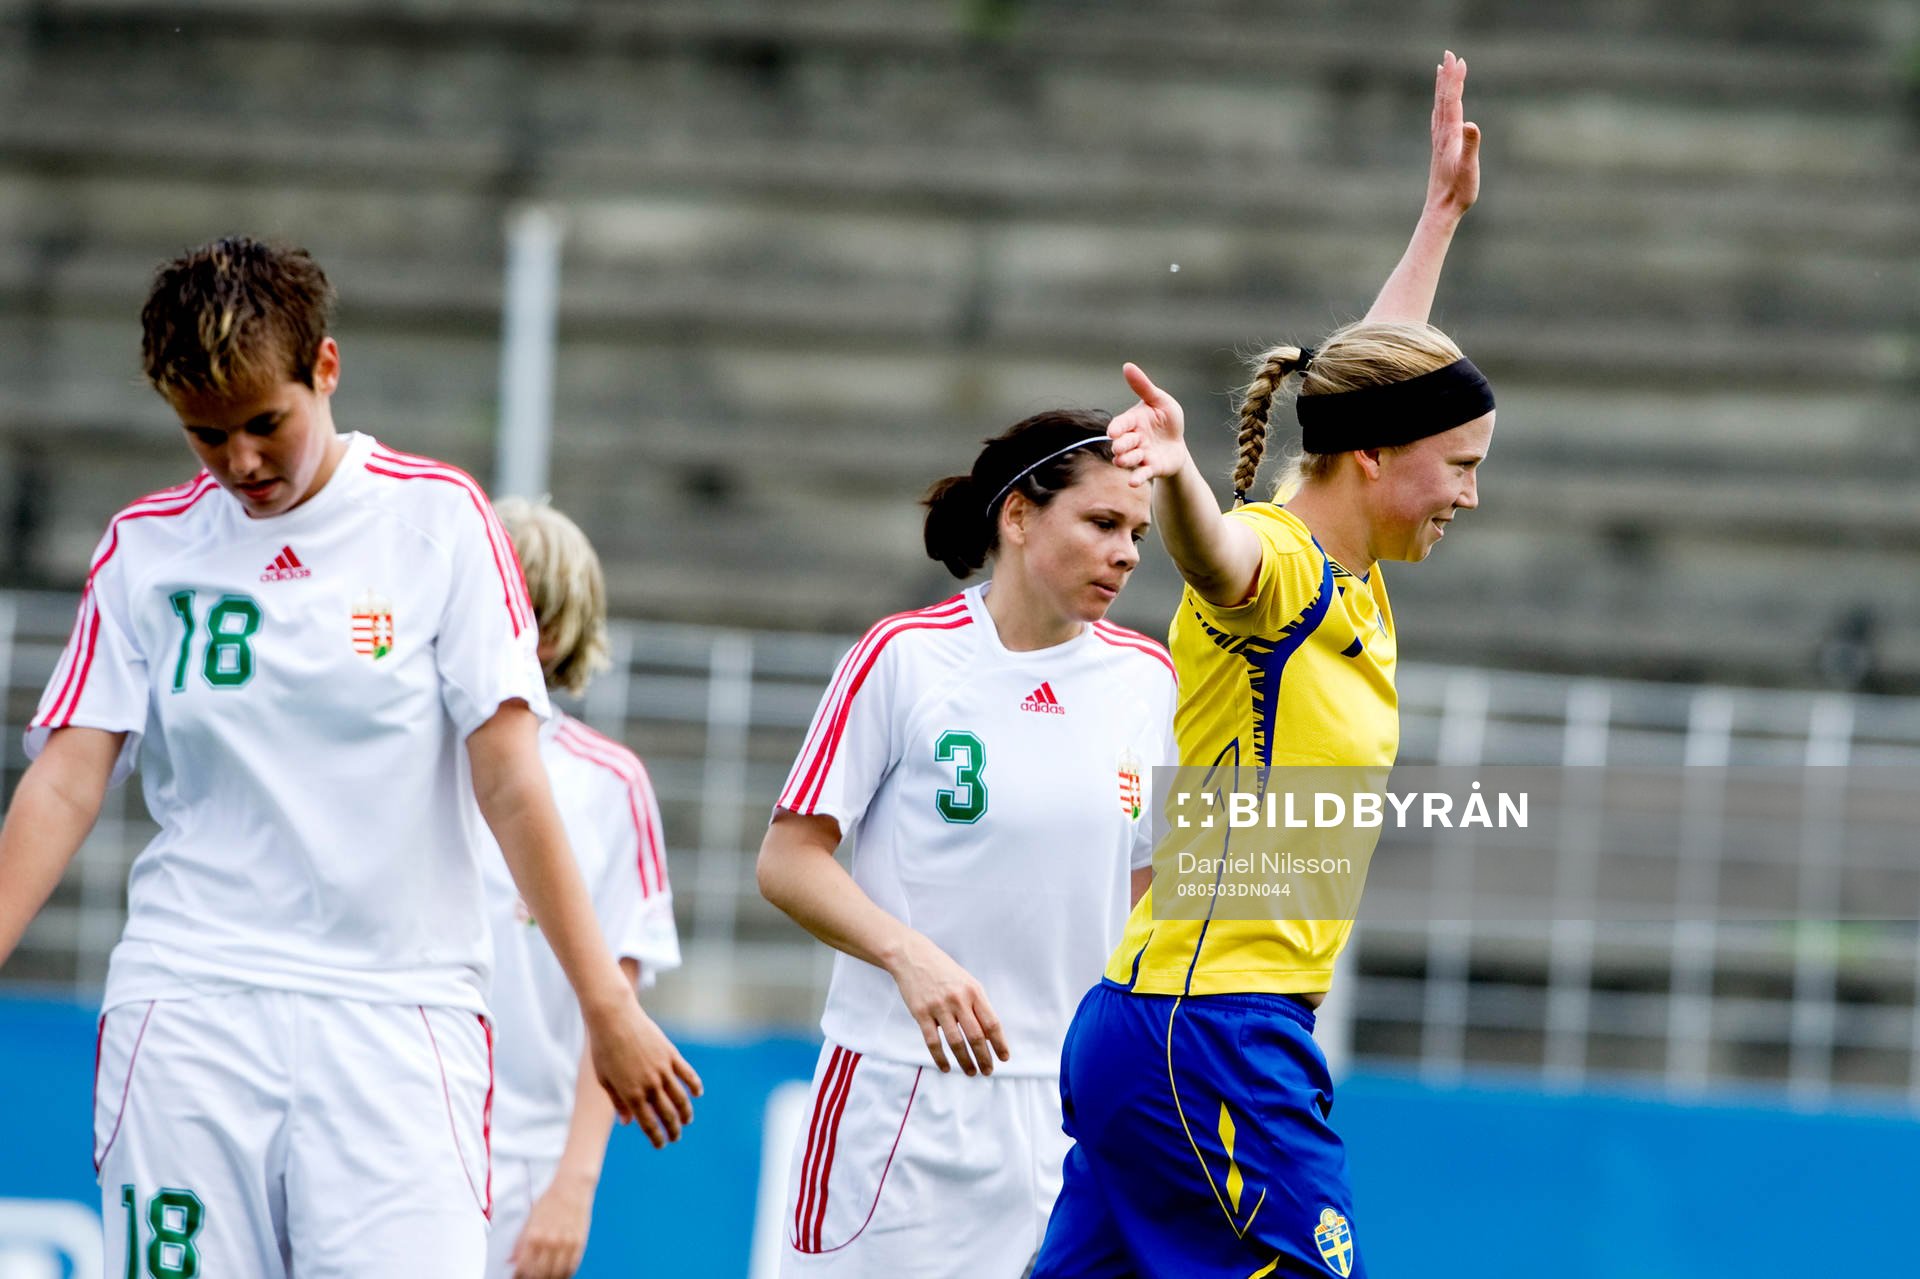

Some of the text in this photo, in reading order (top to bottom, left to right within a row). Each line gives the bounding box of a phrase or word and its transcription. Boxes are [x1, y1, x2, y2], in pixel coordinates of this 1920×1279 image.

[260, 567, 312, 582] adidas
[169, 590, 264, 694] 18
[1020, 700, 1065, 715] adidas
[934, 729, 989, 825] 3
[121, 1184, 205, 1279] 18
